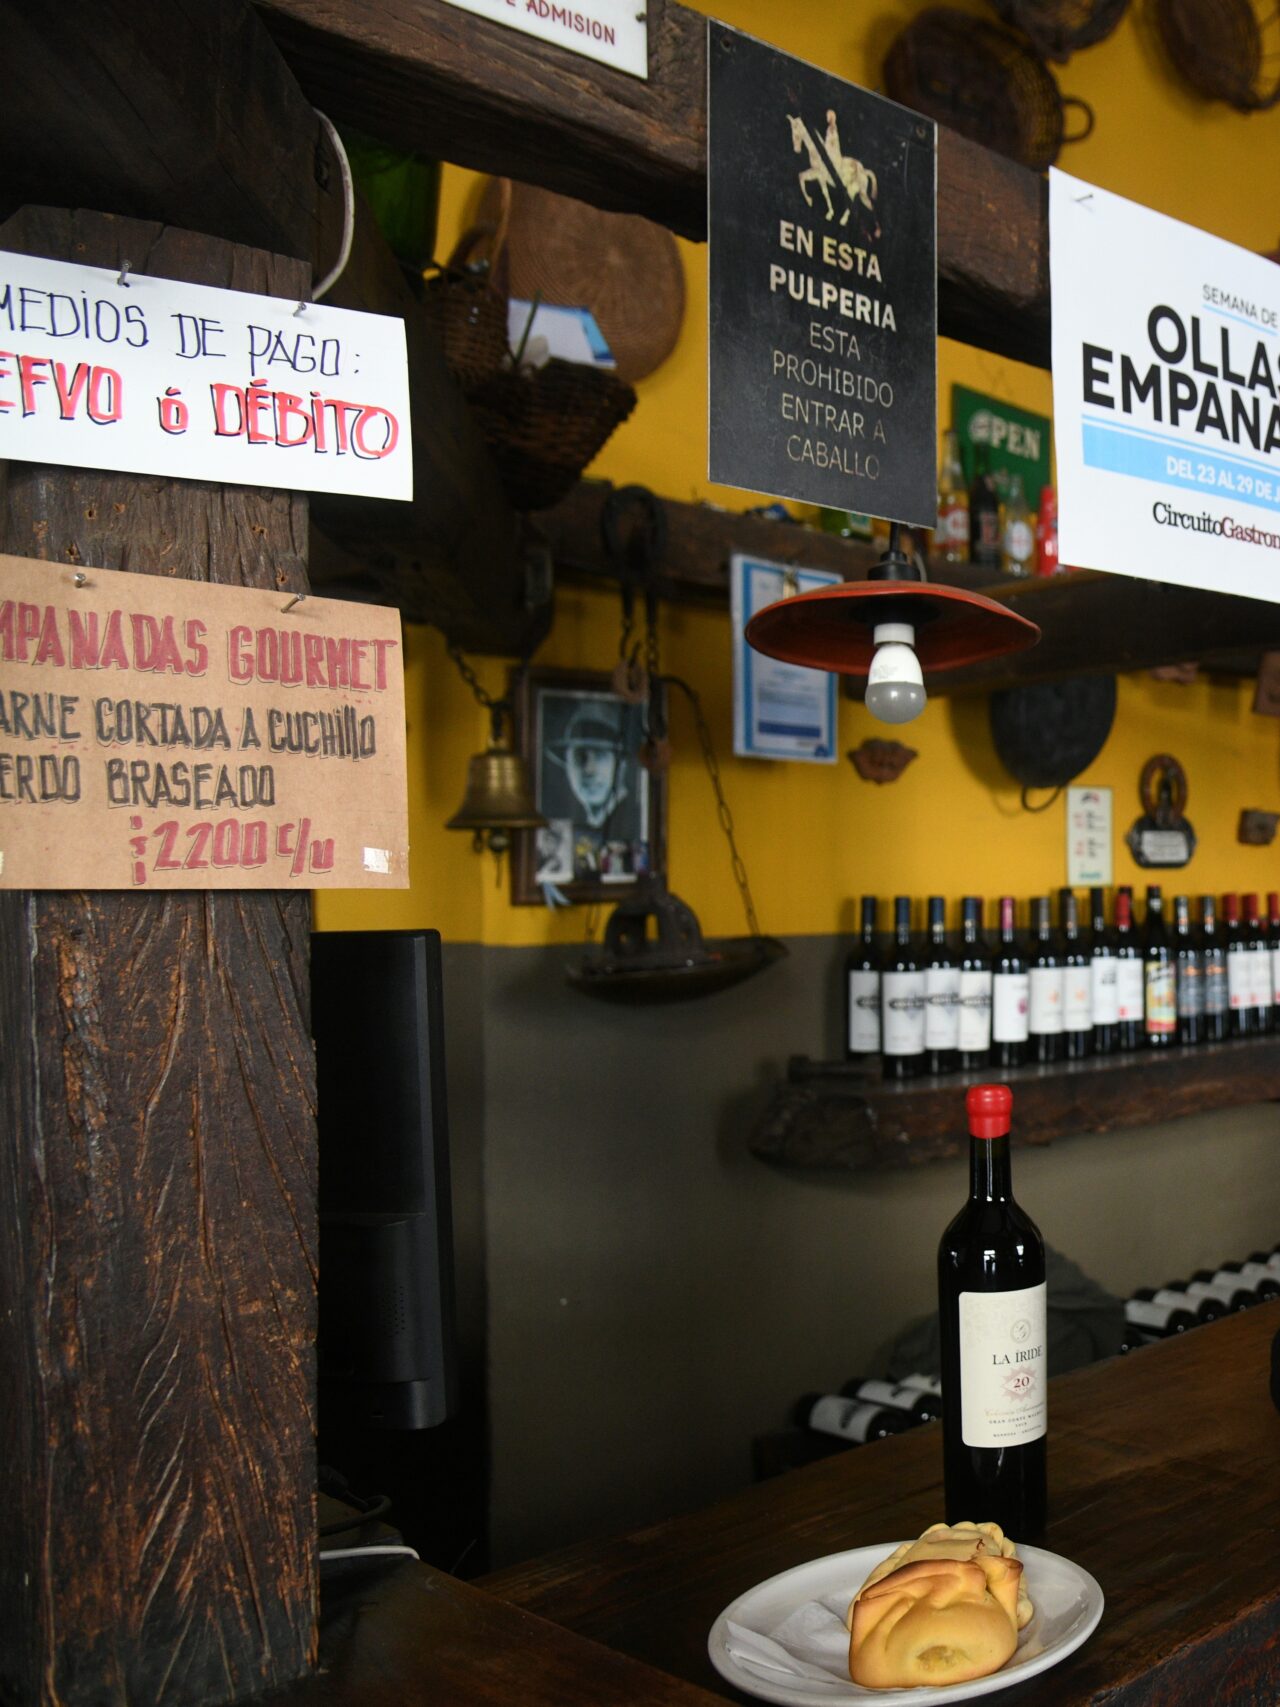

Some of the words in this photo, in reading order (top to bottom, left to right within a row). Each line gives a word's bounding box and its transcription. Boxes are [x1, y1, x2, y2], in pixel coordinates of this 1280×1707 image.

[527, 0, 616, 45] ADMISION
[780, 220, 814, 258] EN
[822, 237, 882, 283] ESTA
[769, 264, 897, 332] PULPERIA
[1203, 284, 1257, 319] SEMANA
[1262, 308, 1278, 328] DE
[171, 313, 226, 358] DE
[810, 322, 861, 361] ESTA
[773, 350, 893, 408] PROHIBIDO
[782, 393, 864, 439] ENTRAR
[873, 419, 886, 444] A
[969, 409, 1041, 461] OPEN
[787, 435, 879, 481] CABALLO
[1166, 456, 1195, 480] DEL
[1197, 463, 1216, 484] 23
[1218, 469, 1236, 490] AL
[1236, 474, 1253, 494] 29
[1255, 480, 1273, 500] DE
[228, 625, 398, 692] GOURMET
[95, 697, 231, 751] CORTADA
[238, 706, 262, 751] A
[106, 757, 276, 811] BRASEADO
[993, 1353, 1011, 1365] LA
[1014, 1376, 1030, 1388] 20
